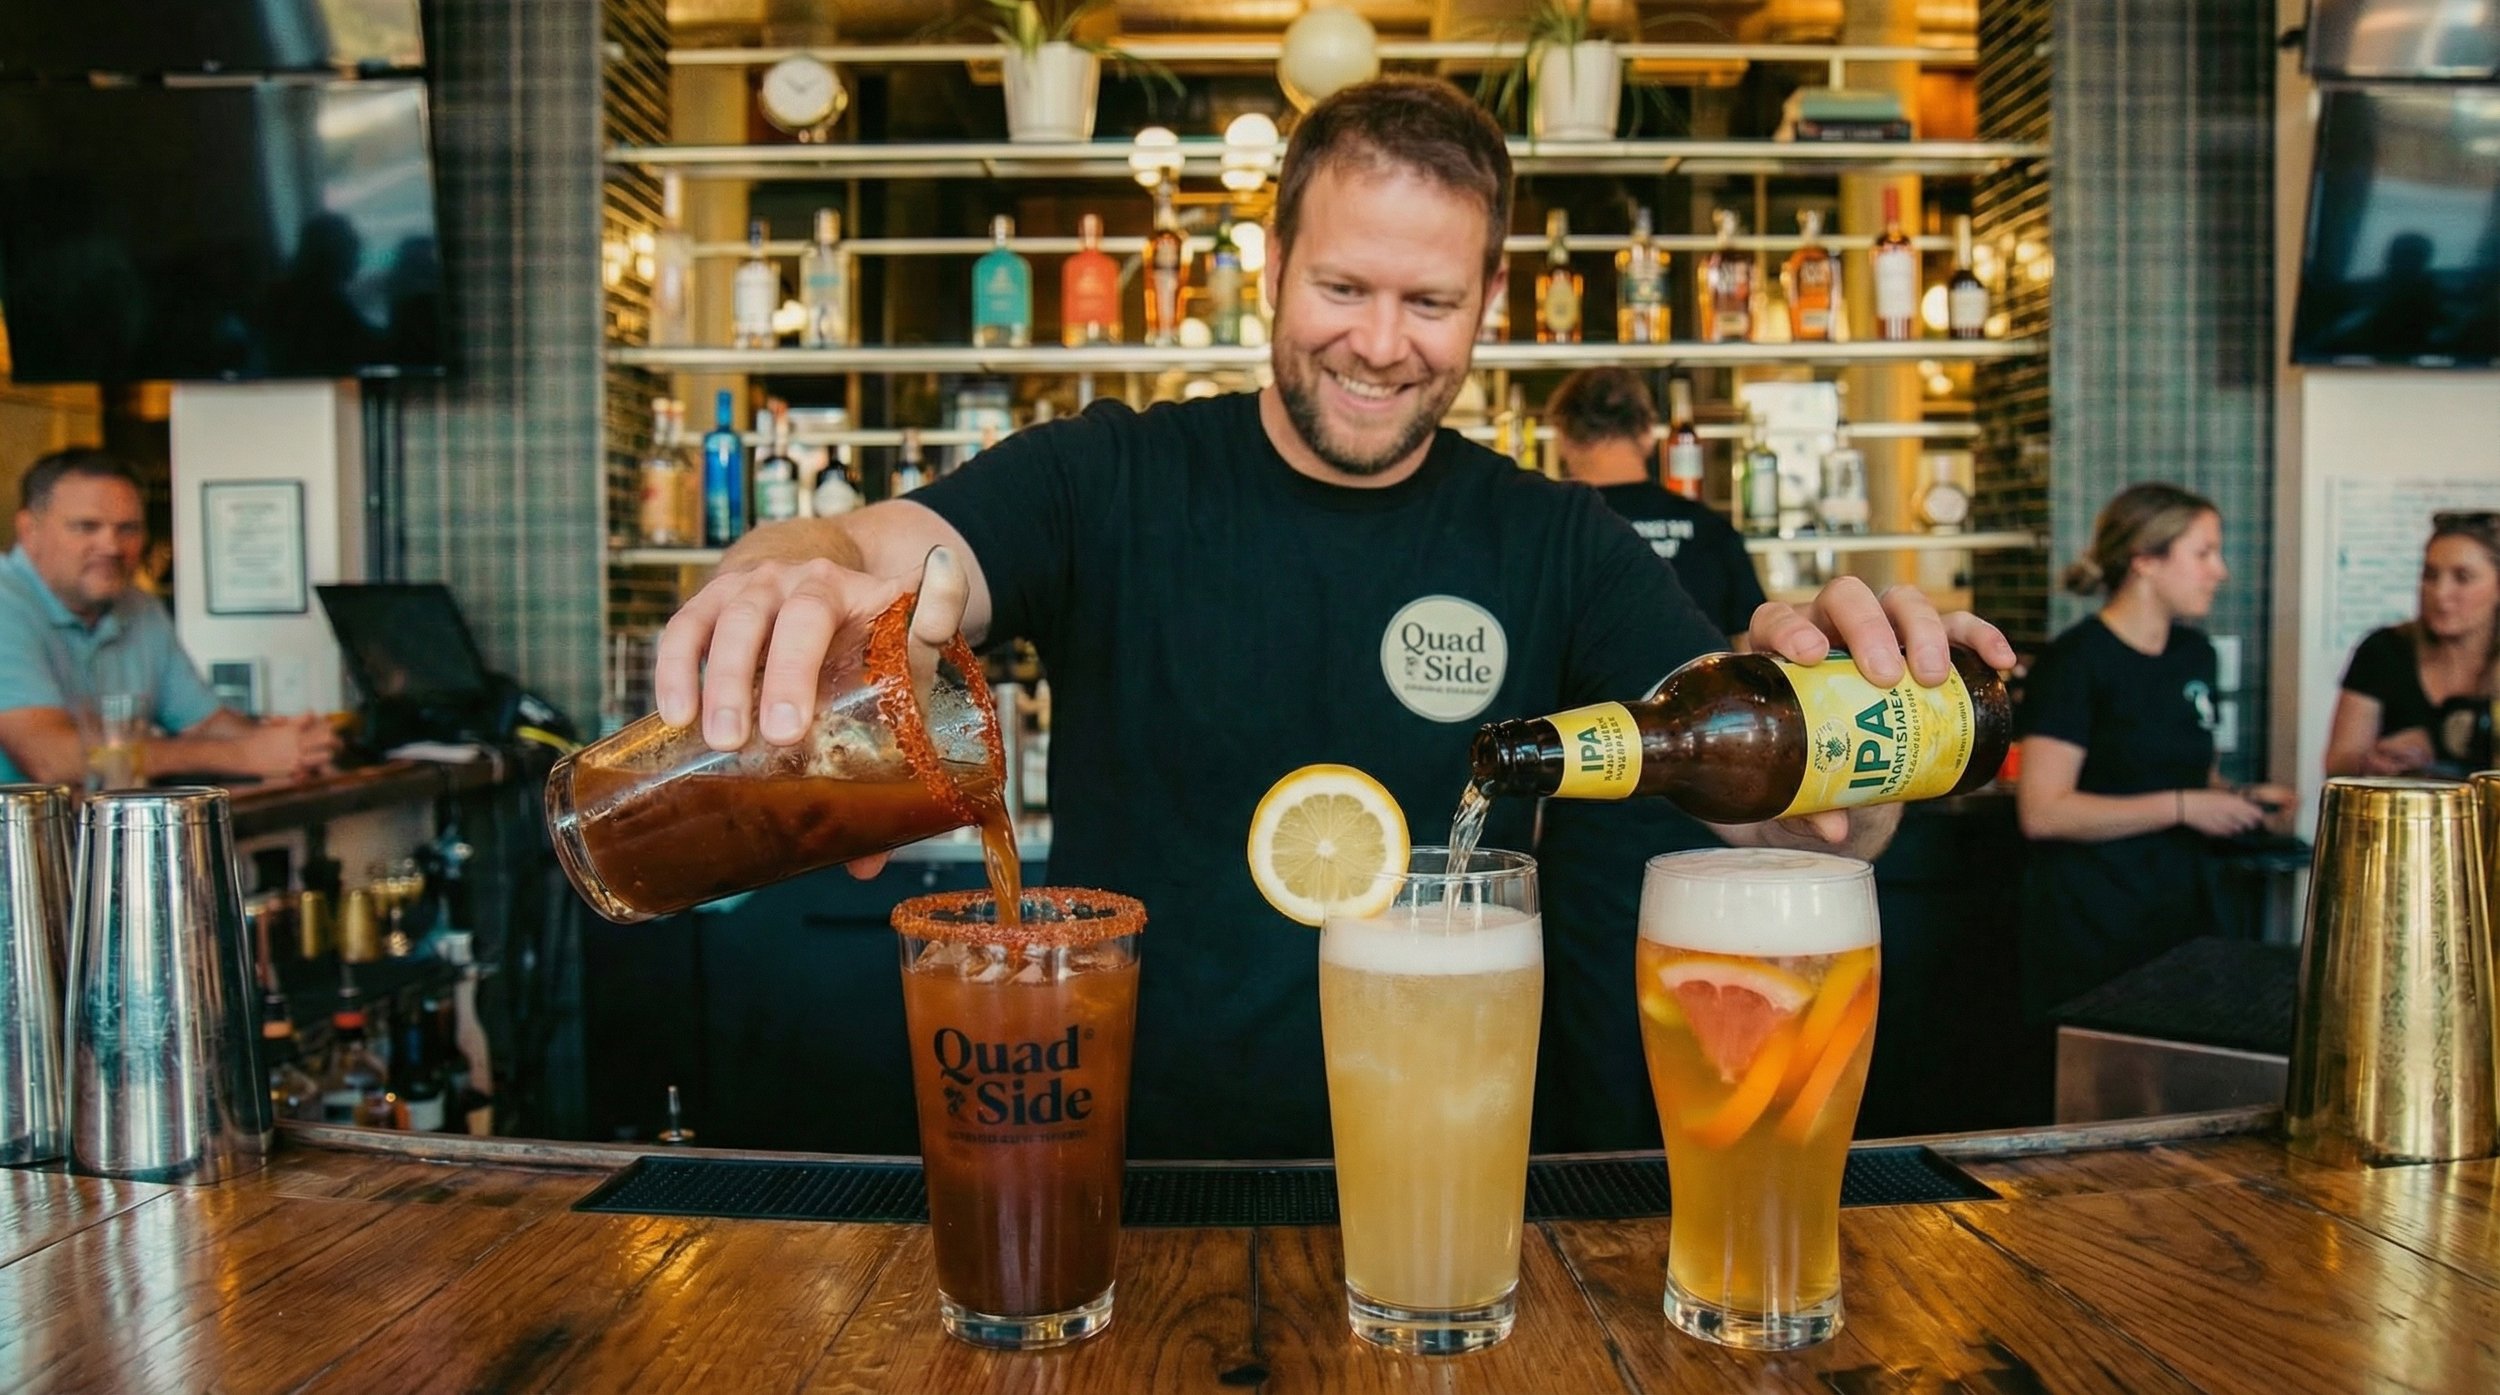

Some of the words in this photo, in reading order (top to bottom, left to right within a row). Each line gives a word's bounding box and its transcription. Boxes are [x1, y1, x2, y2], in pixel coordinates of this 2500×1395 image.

[1402, 622, 1486, 656] Quad
[1424, 655, 1492, 683] Side
[1577, 727, 1604, 773] IPA
[1849, 698, 1894, 789] IPA
[933, 1024, 1080, 1085] Quad
[976, 1077, 1093, 1126] Side
